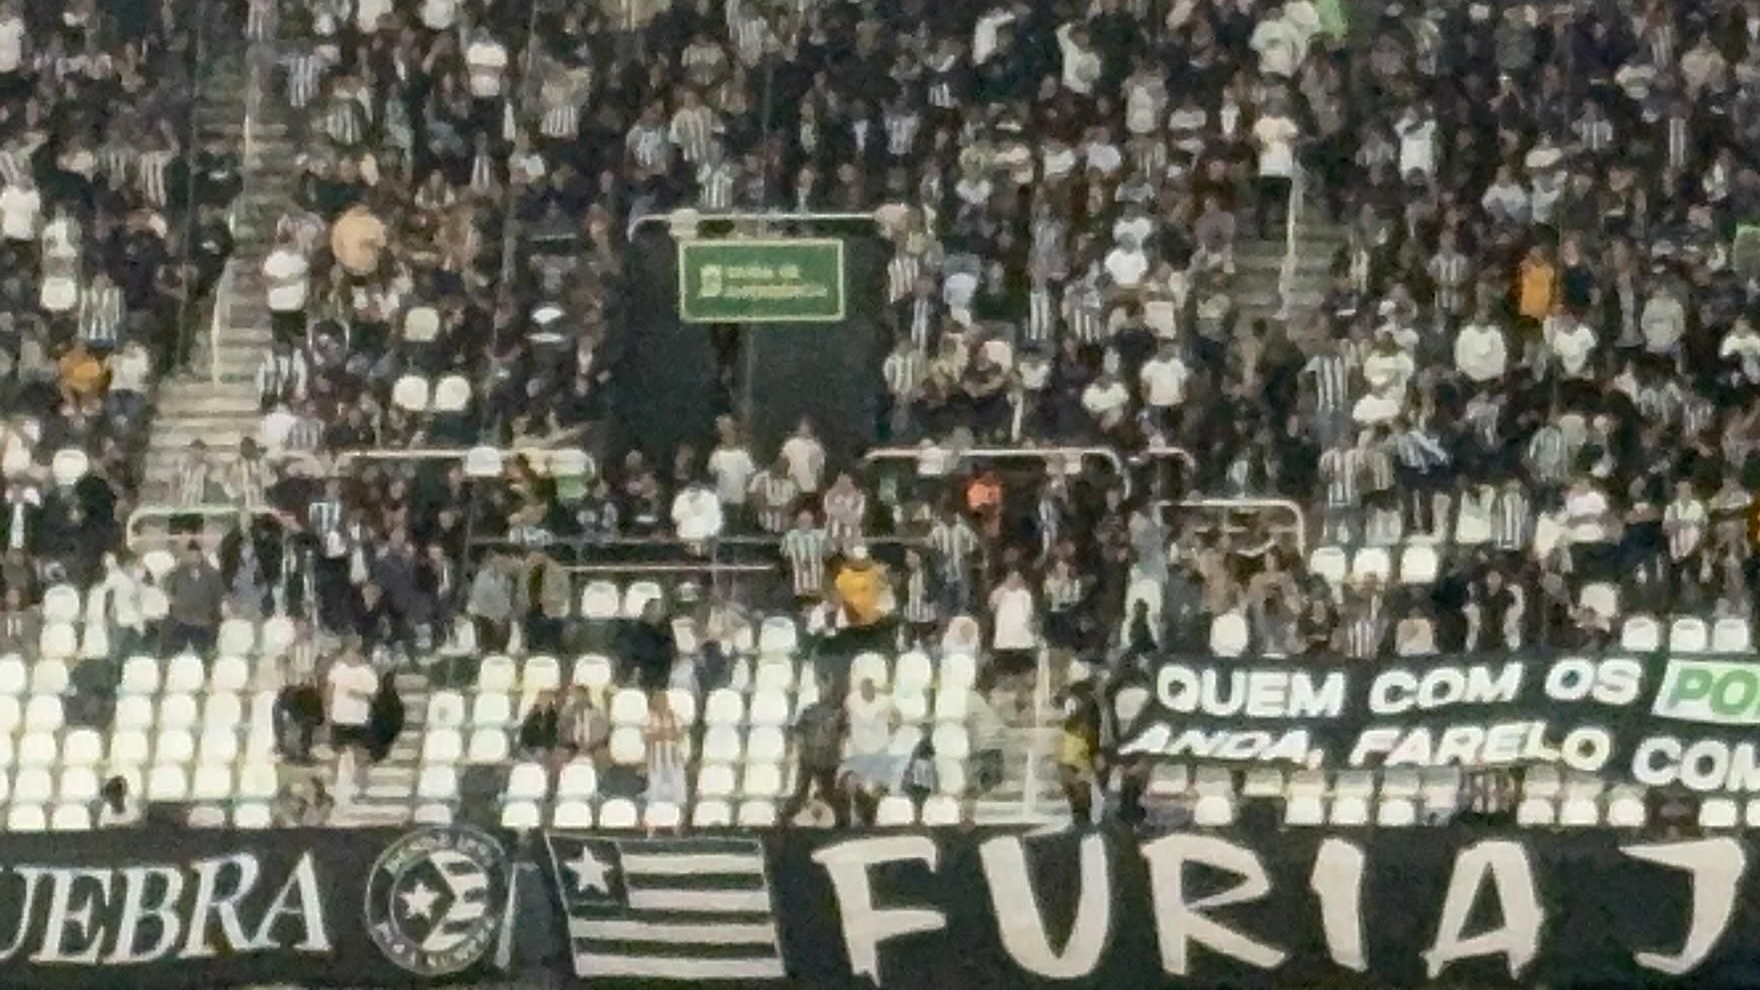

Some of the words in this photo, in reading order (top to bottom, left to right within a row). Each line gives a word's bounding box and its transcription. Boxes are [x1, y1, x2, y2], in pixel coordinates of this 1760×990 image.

[1157, 665, 1344, 718] QUEM
[1369, 663, 1523, 713] COM
[1545, 657, 1643, 705] OS
[1118, 724, 1324, 769] ANDA,
[1349, 721, 1611, 772] FARELO
[811, 834, 1545, 987] FURIA
